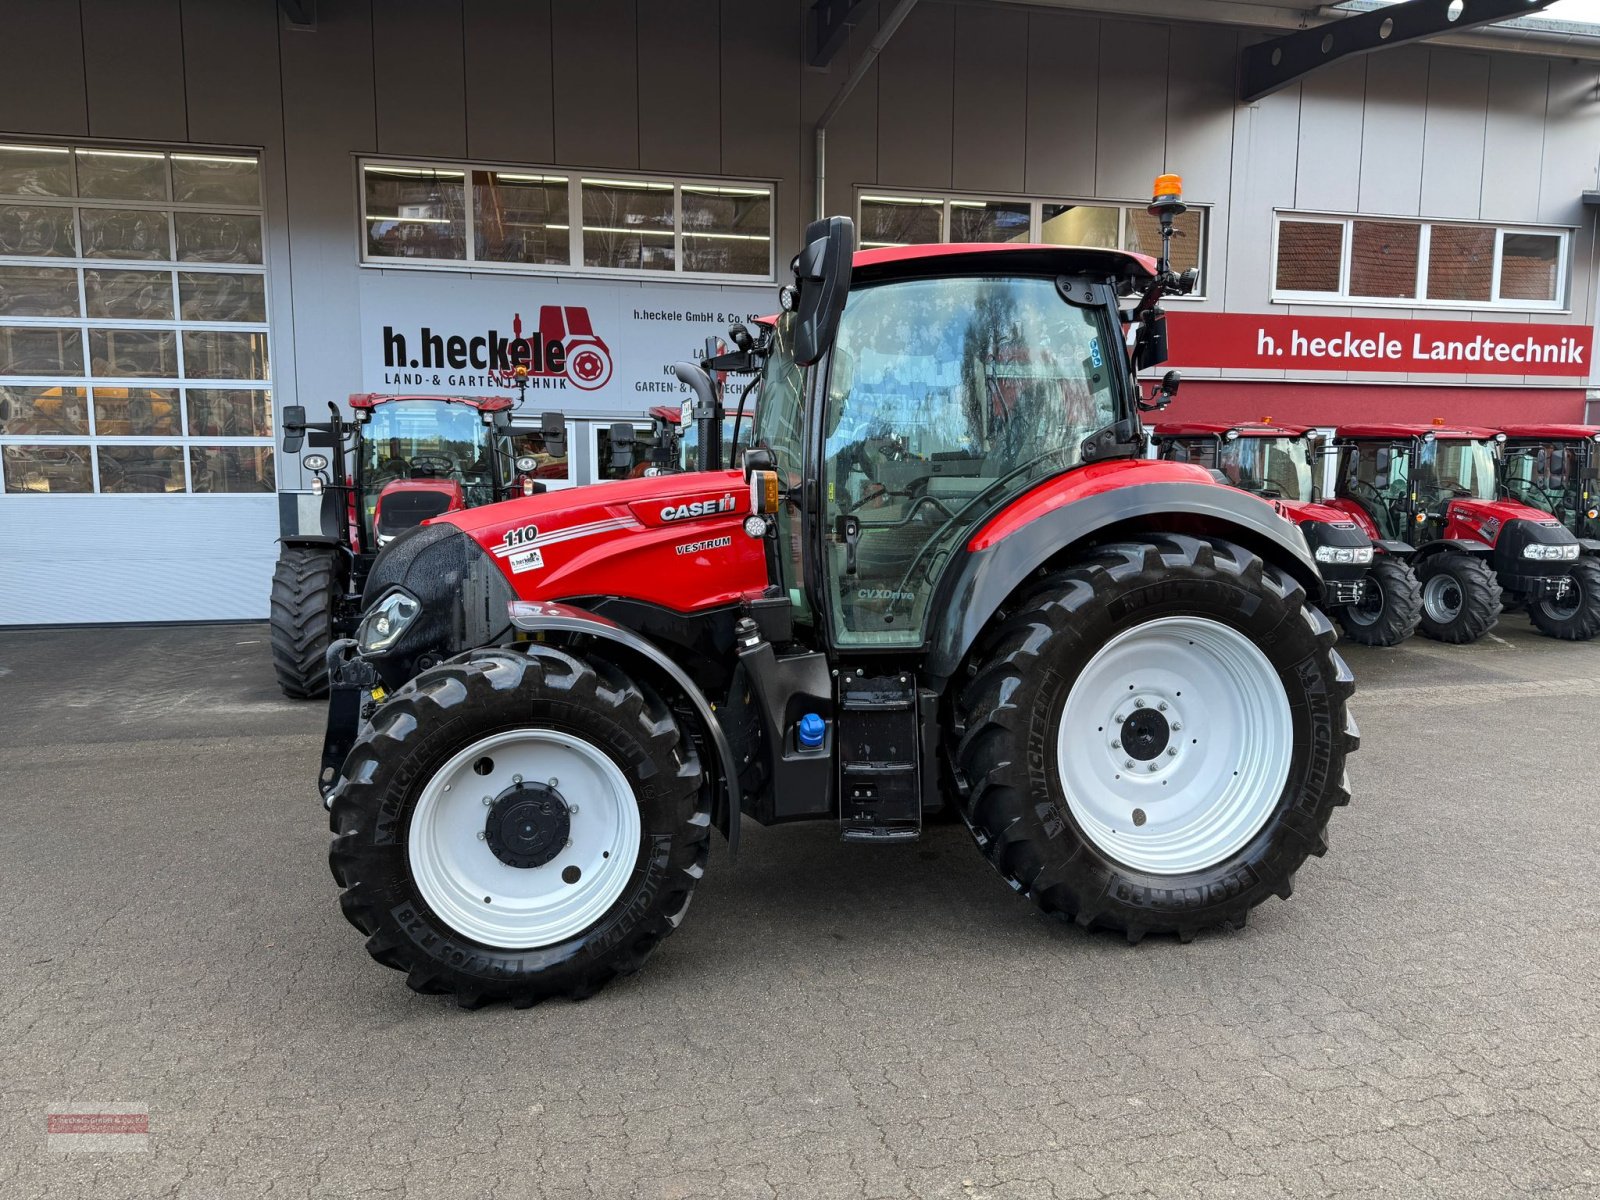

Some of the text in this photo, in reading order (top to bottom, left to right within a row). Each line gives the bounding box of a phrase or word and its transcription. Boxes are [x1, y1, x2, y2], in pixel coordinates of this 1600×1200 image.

[633, 309, 682, 321] h.heckele
[685, 311, 714, 323] GmbH
[717, 313, 725, 323] &
[728, 313, 743, 324] Co.
[383, 326, 567, 373] h.heckele
[1257, 328, 1583, 364] h. heckele Landtechnik
[635, 381, 678, 393] GARTEN-
[680, 383, 687, 393] &
[660, 500, 716, 521] CASE
[503, 524, 539, 547] 110
[676, 536, 732, 555] VESTRUM
[857, 588, 915, 600] CVXDrive
[1297, 692, 1332, 818] MICHELIN
